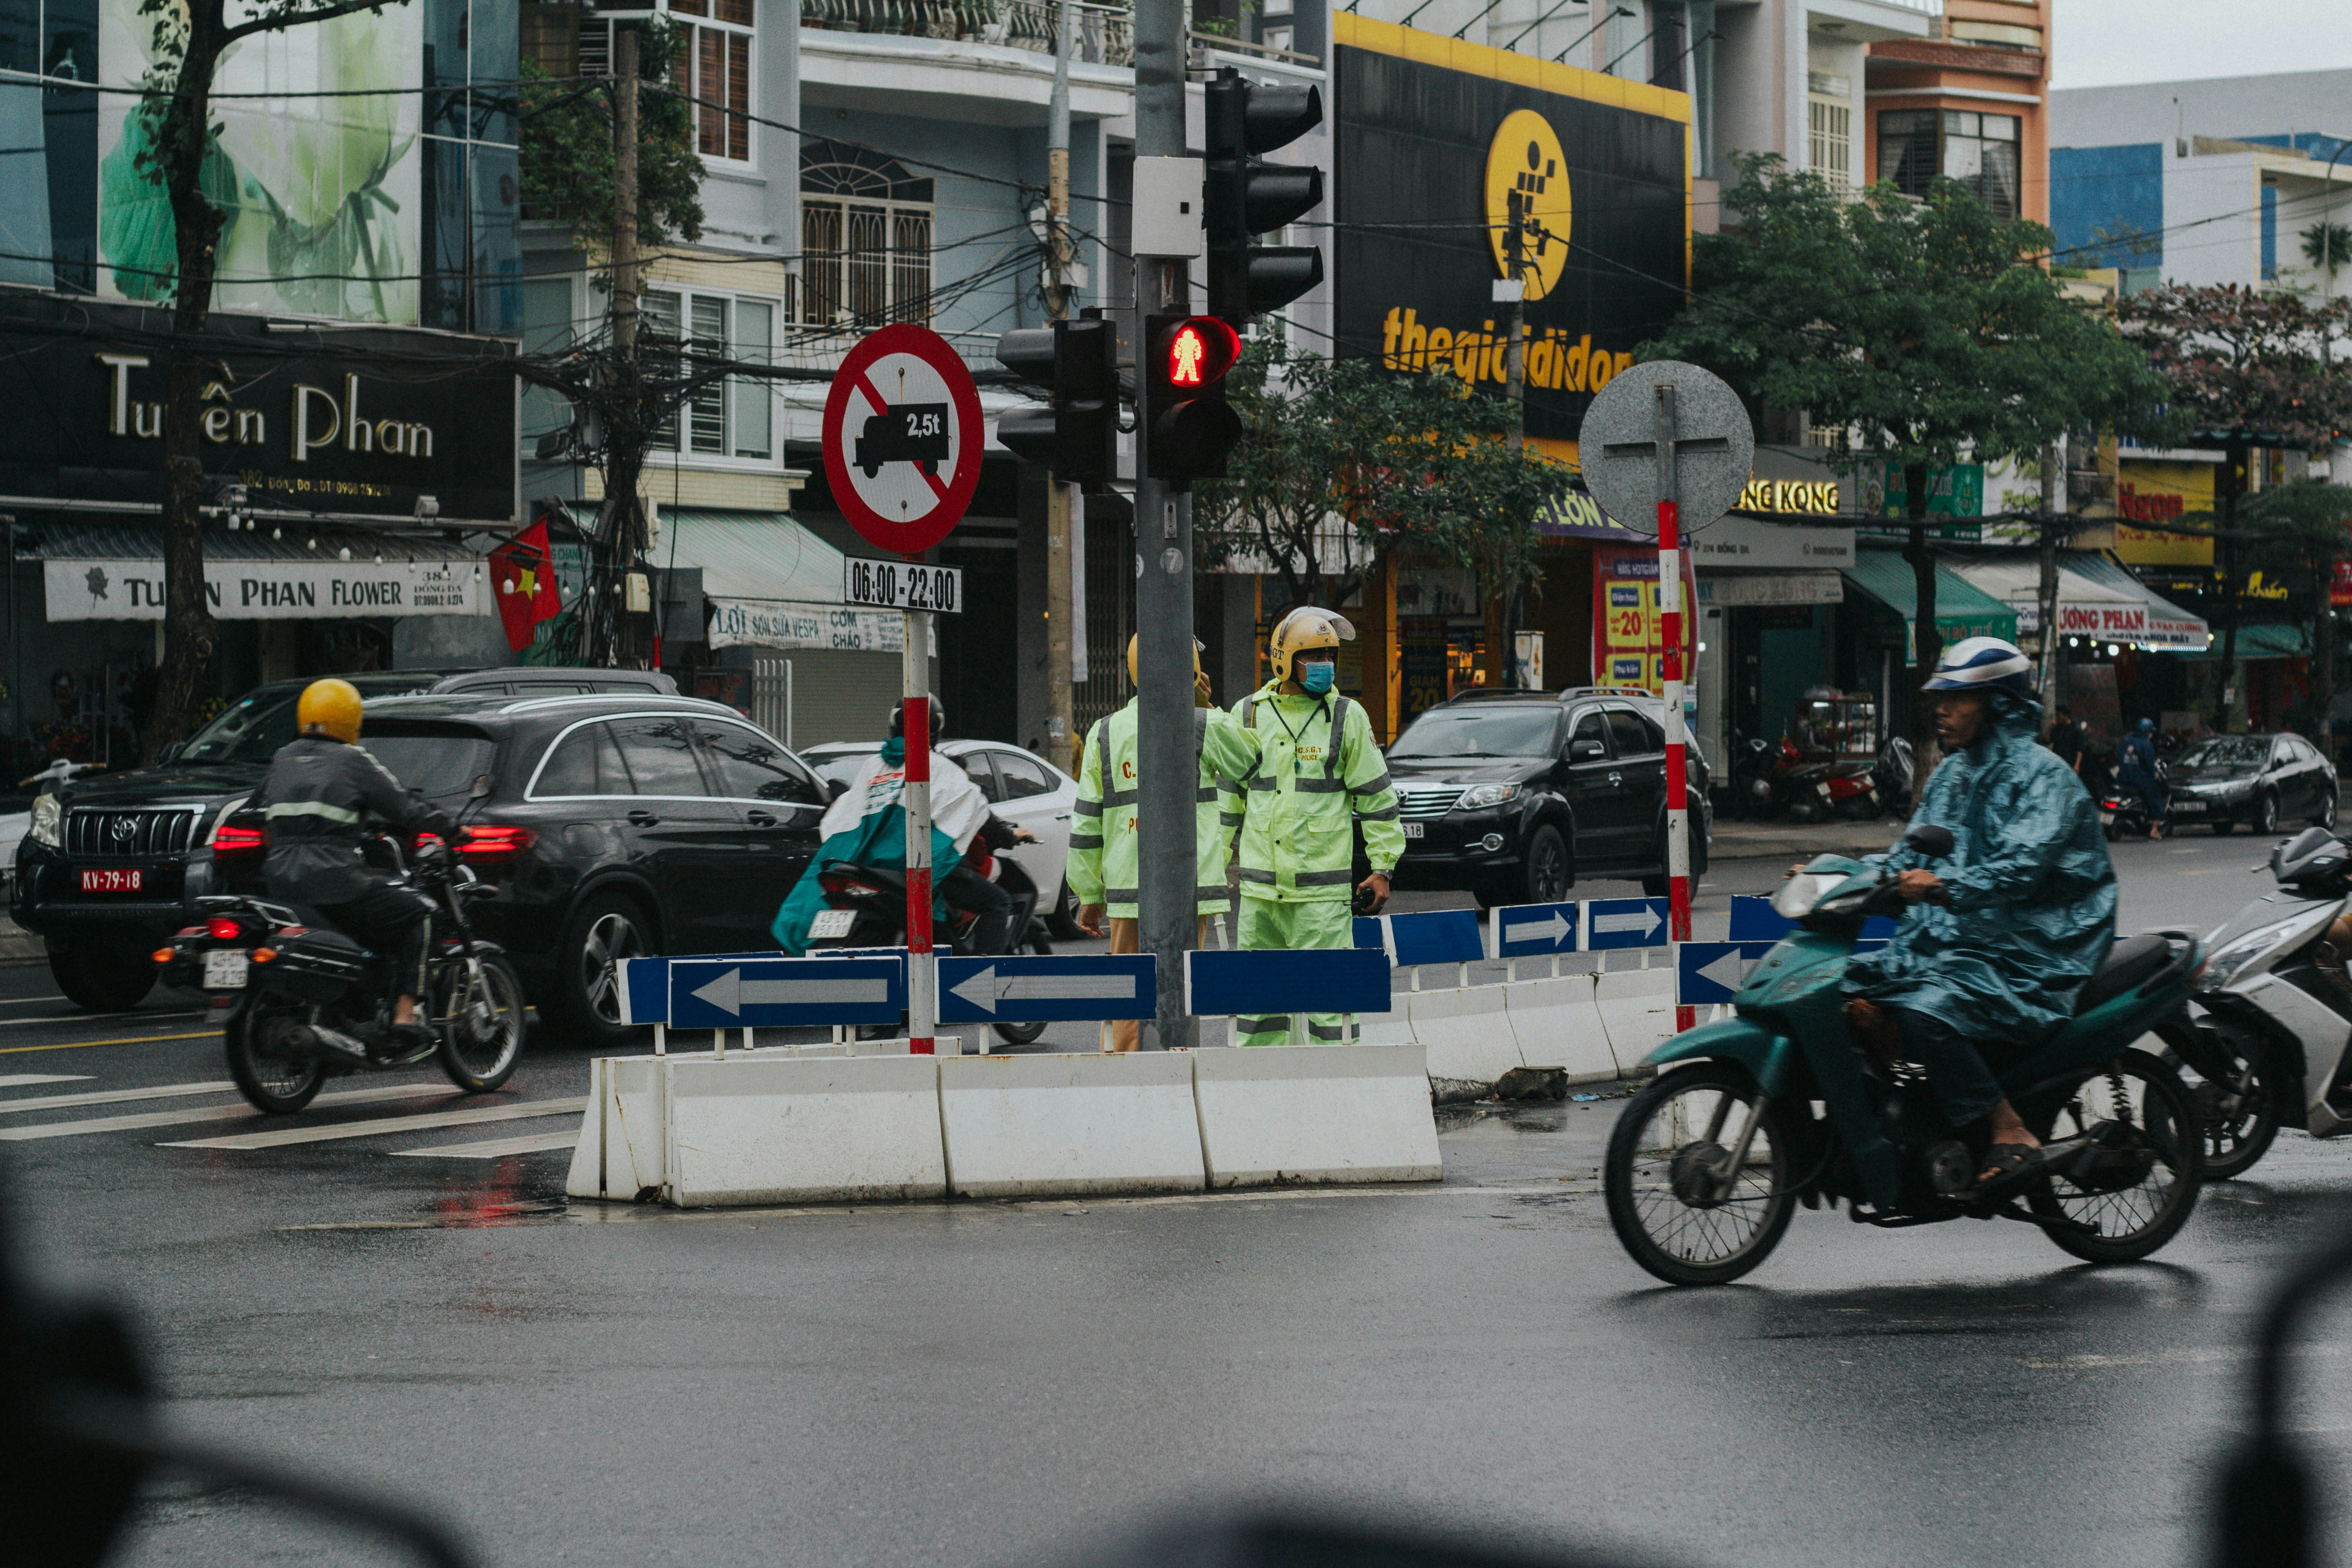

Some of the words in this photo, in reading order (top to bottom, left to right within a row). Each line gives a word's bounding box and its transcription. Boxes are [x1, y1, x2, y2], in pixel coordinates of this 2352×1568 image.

[95, 353, 265, 445] Tuền
[290, 372, 433, 461] Phan
[906, 413, 940, 439] 2,5t
[1774, 480, 1839, 514] KONG
[123, 578, 220, 608] TUN
[240, 578, 314, 608] PHAN
[332, 579, 402, 605] FLOWER
[852, 562, 896, 605] 06:00
[908, 567, 955, 611] 22:00
[716, 604, 748, 641] LỢI
[792, 617, 820, 639] VESPA
[830, 607, 858, 628] CƠM
[1621, 611, 1641, 637] 20
[2102, 609, 2144, 630] PHAN
[832, 629, 861, 649] CHÁO
[83, 871, 140, 889] KV-79-18
